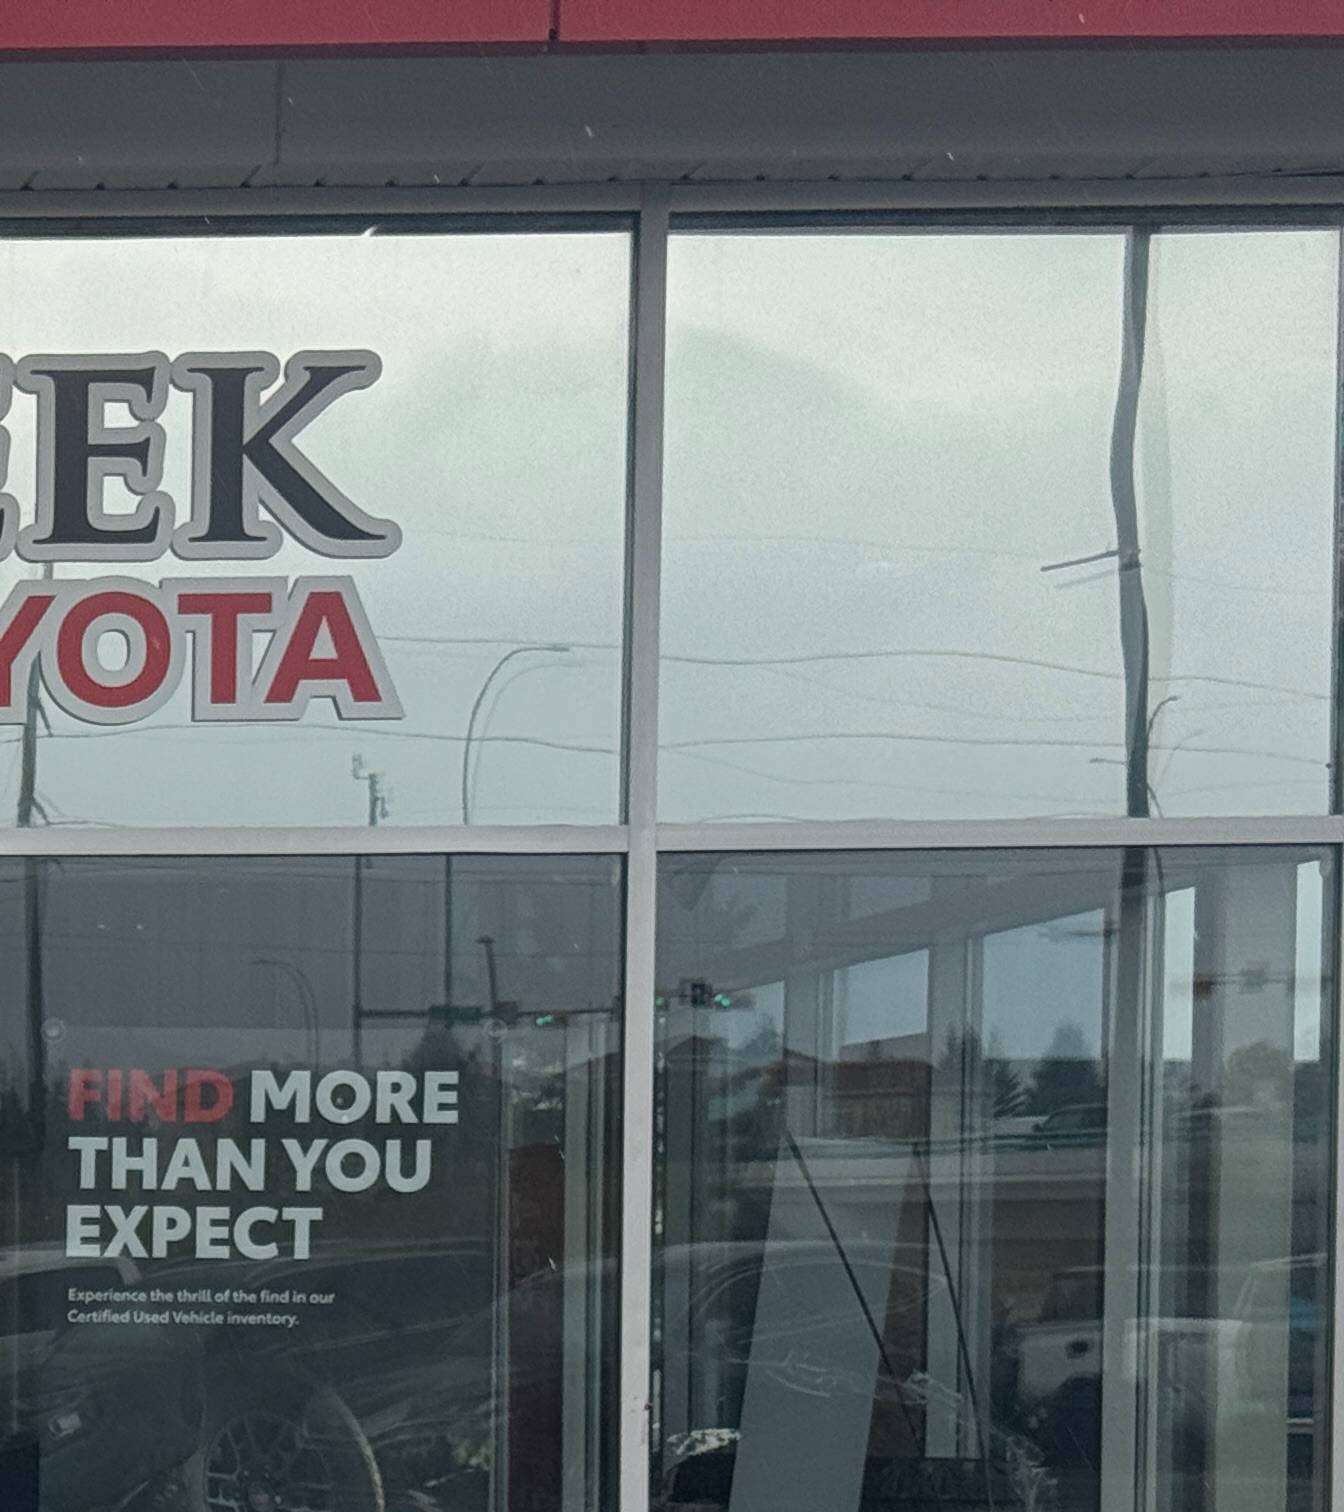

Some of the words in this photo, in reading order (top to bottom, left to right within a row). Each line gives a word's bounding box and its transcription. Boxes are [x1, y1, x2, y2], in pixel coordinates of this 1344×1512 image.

[67, 1067, 234, 1123] FIND
[249, 1069, 459, 1124] MORE
[67, 1136, 266, 1192] THAN
[282, 1138, 433, 1193] YOU
[65, 1204, 324, 1260] EXPECT
[67, 1287, 147, 1305] Experience
[150, 1288, 174, 1302] the
[176, 1288, 212, 1303] thrill
[214, 1288, 230, 1303] of
[232, 1289, 258, 1303] the
[260, 1289, 290, 1304] find
[292, 1290, 307, 1304] in
[309, 1292, 336, 1304] our
[67, 1308, 130, 1323] Certified
[133, 1309, 170, 1324] Used
[172, 1310, 225, 1325] Vehicle
[227, 1311, 300, 1328] inventory.
